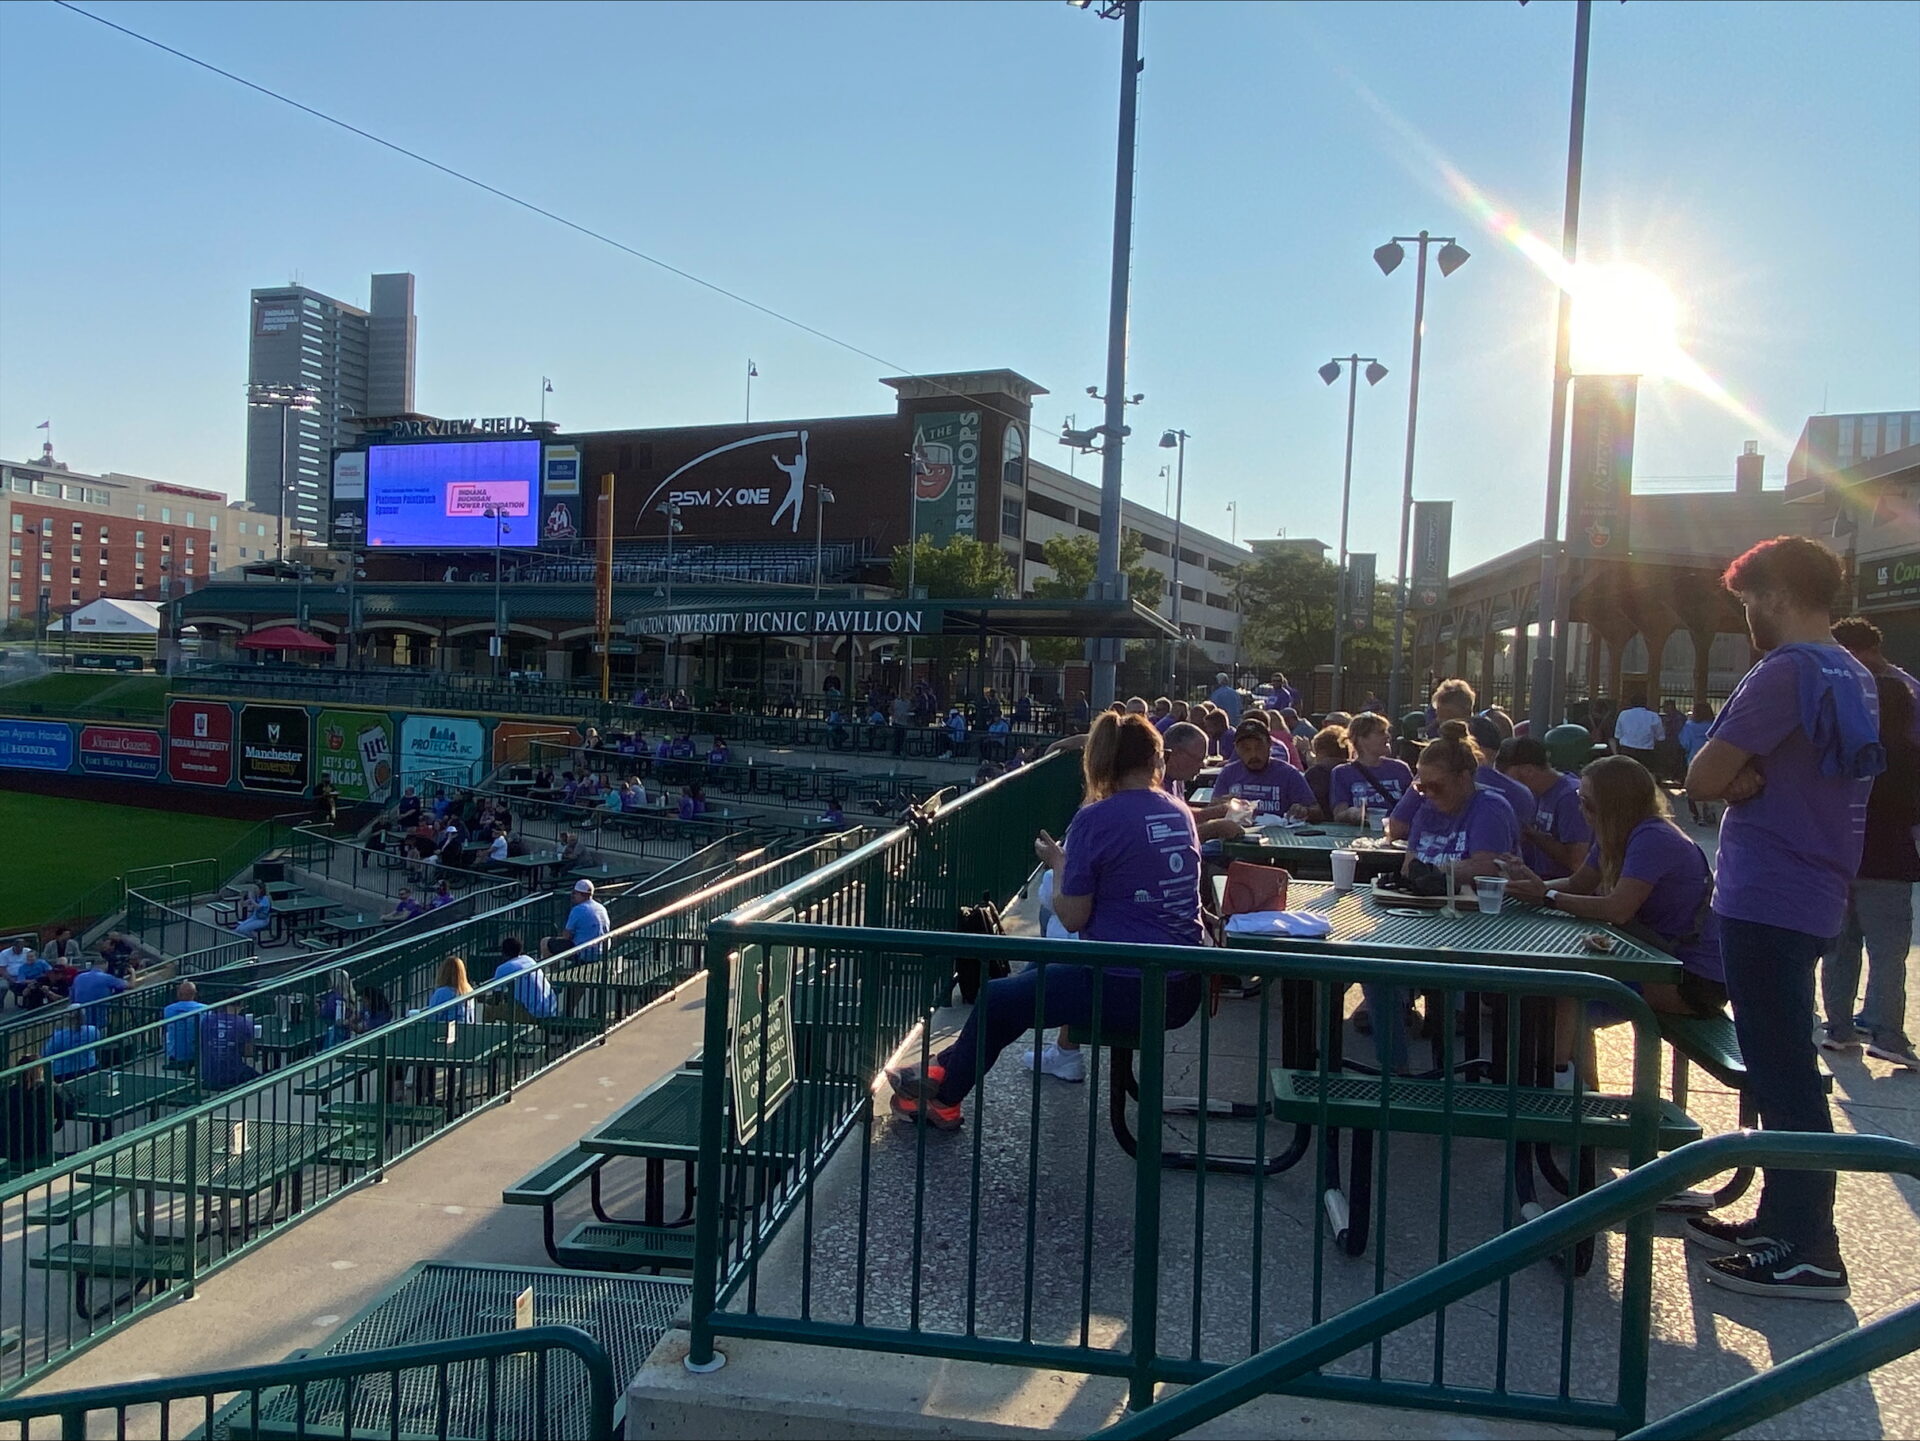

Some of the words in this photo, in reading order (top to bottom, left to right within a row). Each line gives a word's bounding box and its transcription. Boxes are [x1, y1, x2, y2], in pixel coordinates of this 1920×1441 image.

[481, 416, 527, 434] FIELD
[929, 424, 953, 440] THE
[955, 411, 979, 537] REETOPS
[669, 490, 711, 506] PSM
[715, 487, 734, 508] X
[735, 488, 771, 505] ONE
[667, 612, 740, 633] UNIVERSITY
[743, 611, 808, 633] PICNIC
[814, 610, 923, 633] PAVILION
[38, 730, 67, 742] Honda
[11, 744, 57, 757] HONDA
[245, 745, 303, 762] Manchester
[250, 759, 297, 775] University
[344, 758, 357, 770] GO
[321, 769, 363, 786] NCAPS
